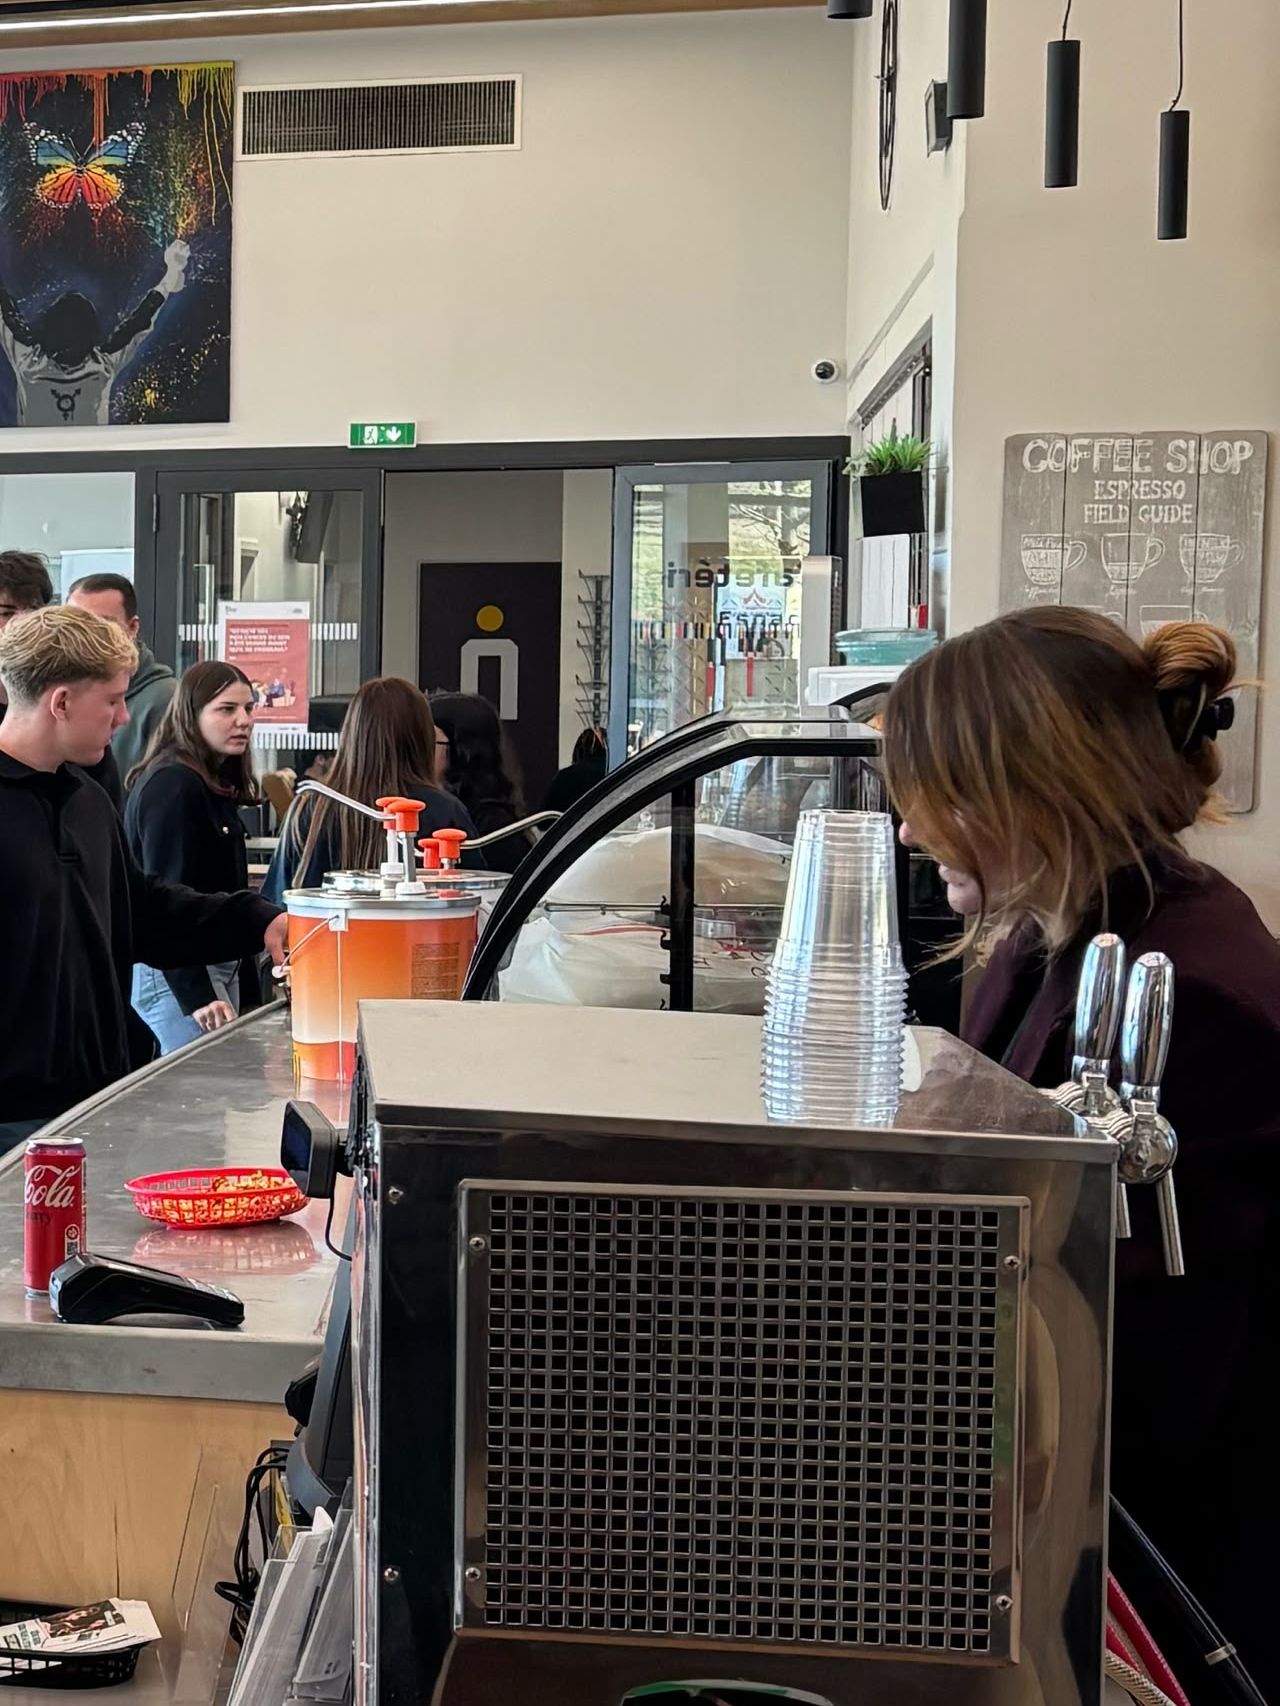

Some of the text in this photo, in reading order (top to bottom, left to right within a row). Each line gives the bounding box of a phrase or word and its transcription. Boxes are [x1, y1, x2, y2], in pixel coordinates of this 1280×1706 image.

[1022, 438, 1254, 475] COFFEE SHOP
[1094, 480, 1186, 500] ESPRESSO
[1084, 504, 1193, 524] FIELD GUIDE
